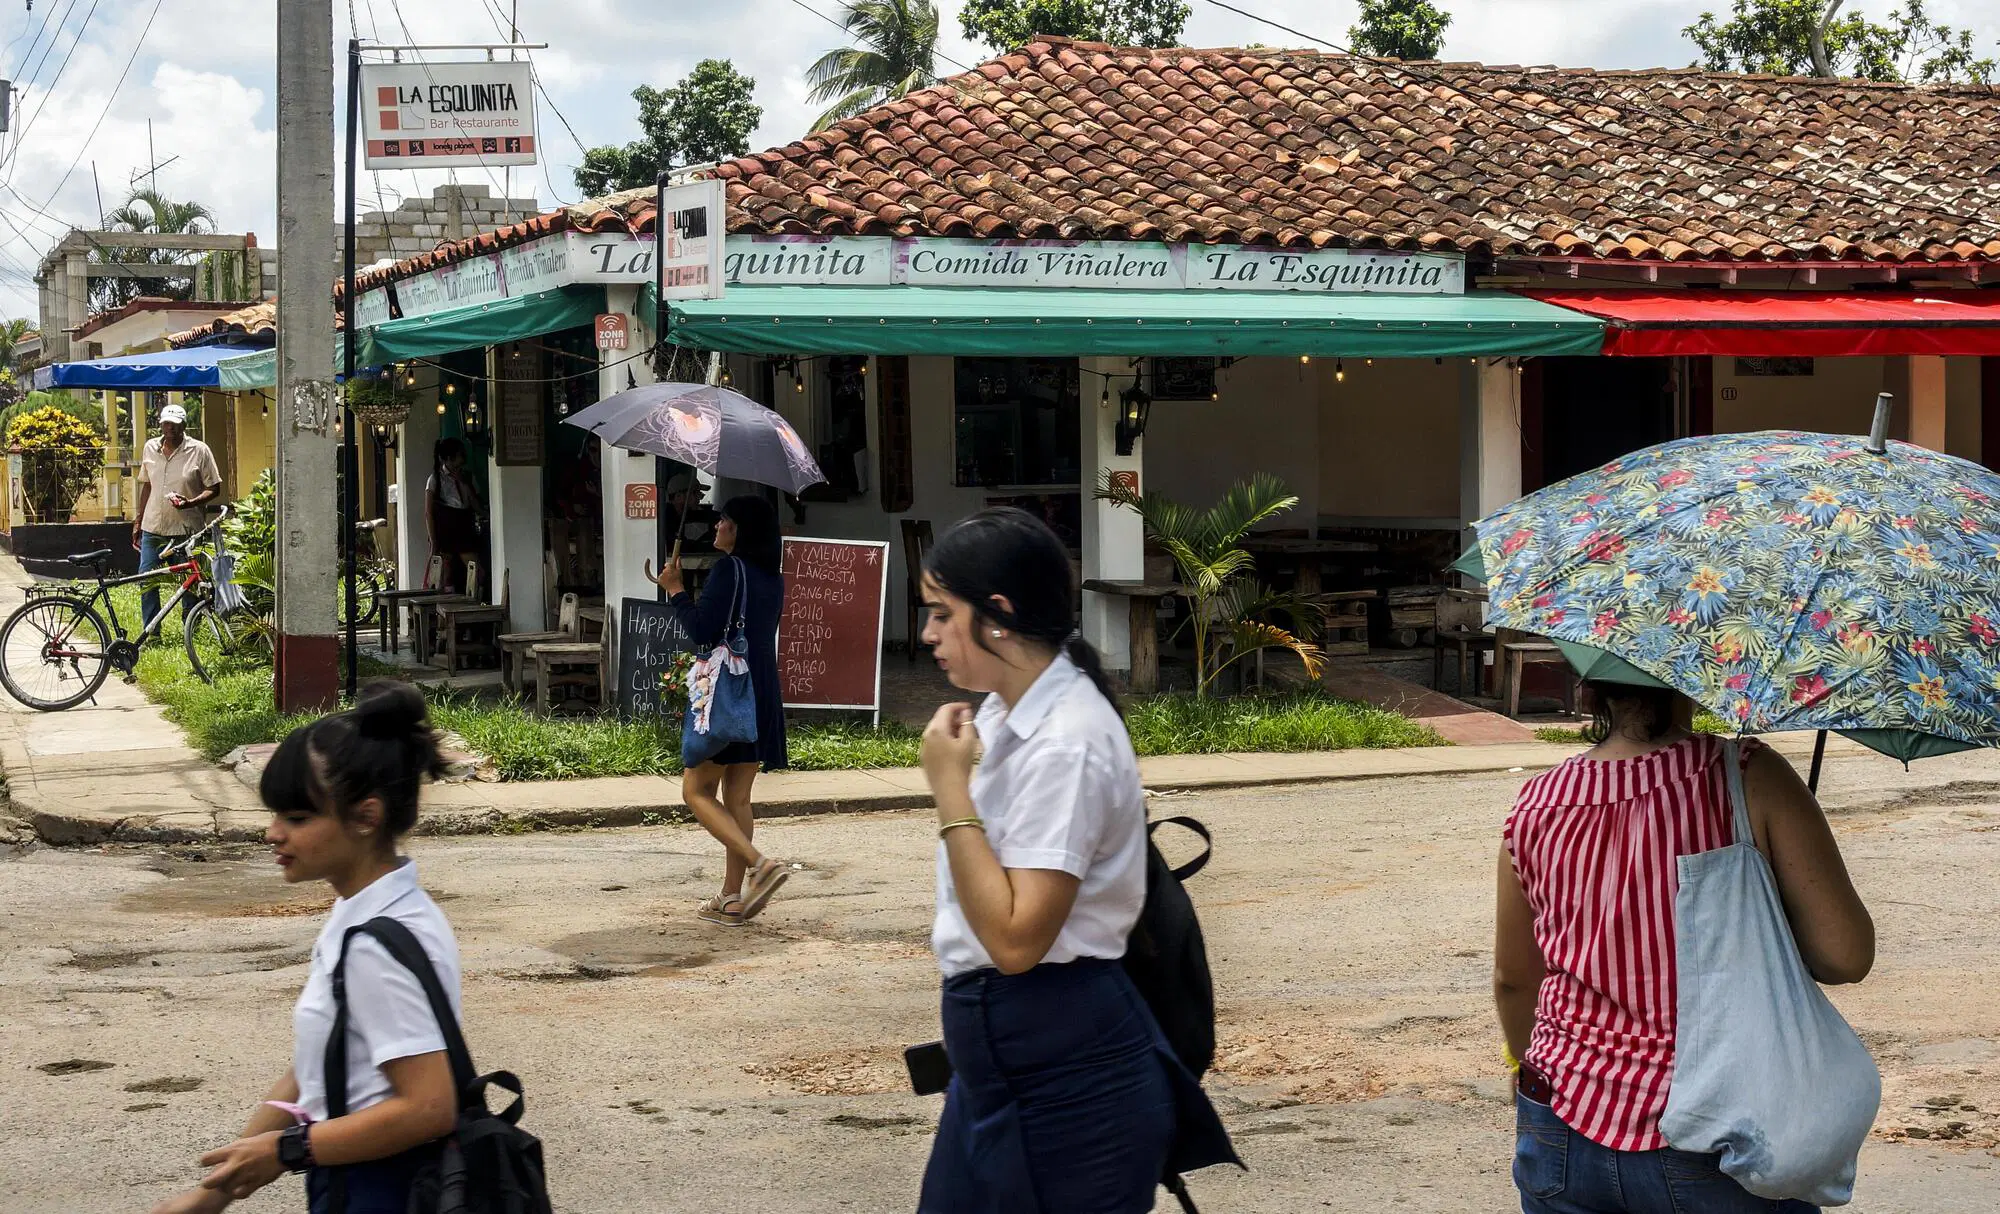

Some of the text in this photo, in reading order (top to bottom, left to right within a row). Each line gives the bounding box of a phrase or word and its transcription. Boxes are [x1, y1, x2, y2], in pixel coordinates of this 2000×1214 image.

[399, 86, 423, 104] LA
[430, 117, 519, 129] Bar Restaurante
[432, 142, 453, 151] lonely
[453, 142, 474, 151] planet
[590, 243, 866, 283] La quinita
[911, 250, 1168, 278] Comida Viñalera
[1207, 253, 1442, 291] La Esquinita
[599, 330, 625, 339] ZONA
[600, 339, 625, 348] WIFI
[628, 500, 655, 509] ZONA
[629, 508, 655, 517] WIFI
[796, 561, 856, 585] LANGOSTA
[786, 659, 826, 676] PARGO
[632, 670, 661, 691] Cub
[789, 675, 813, 696] RES
